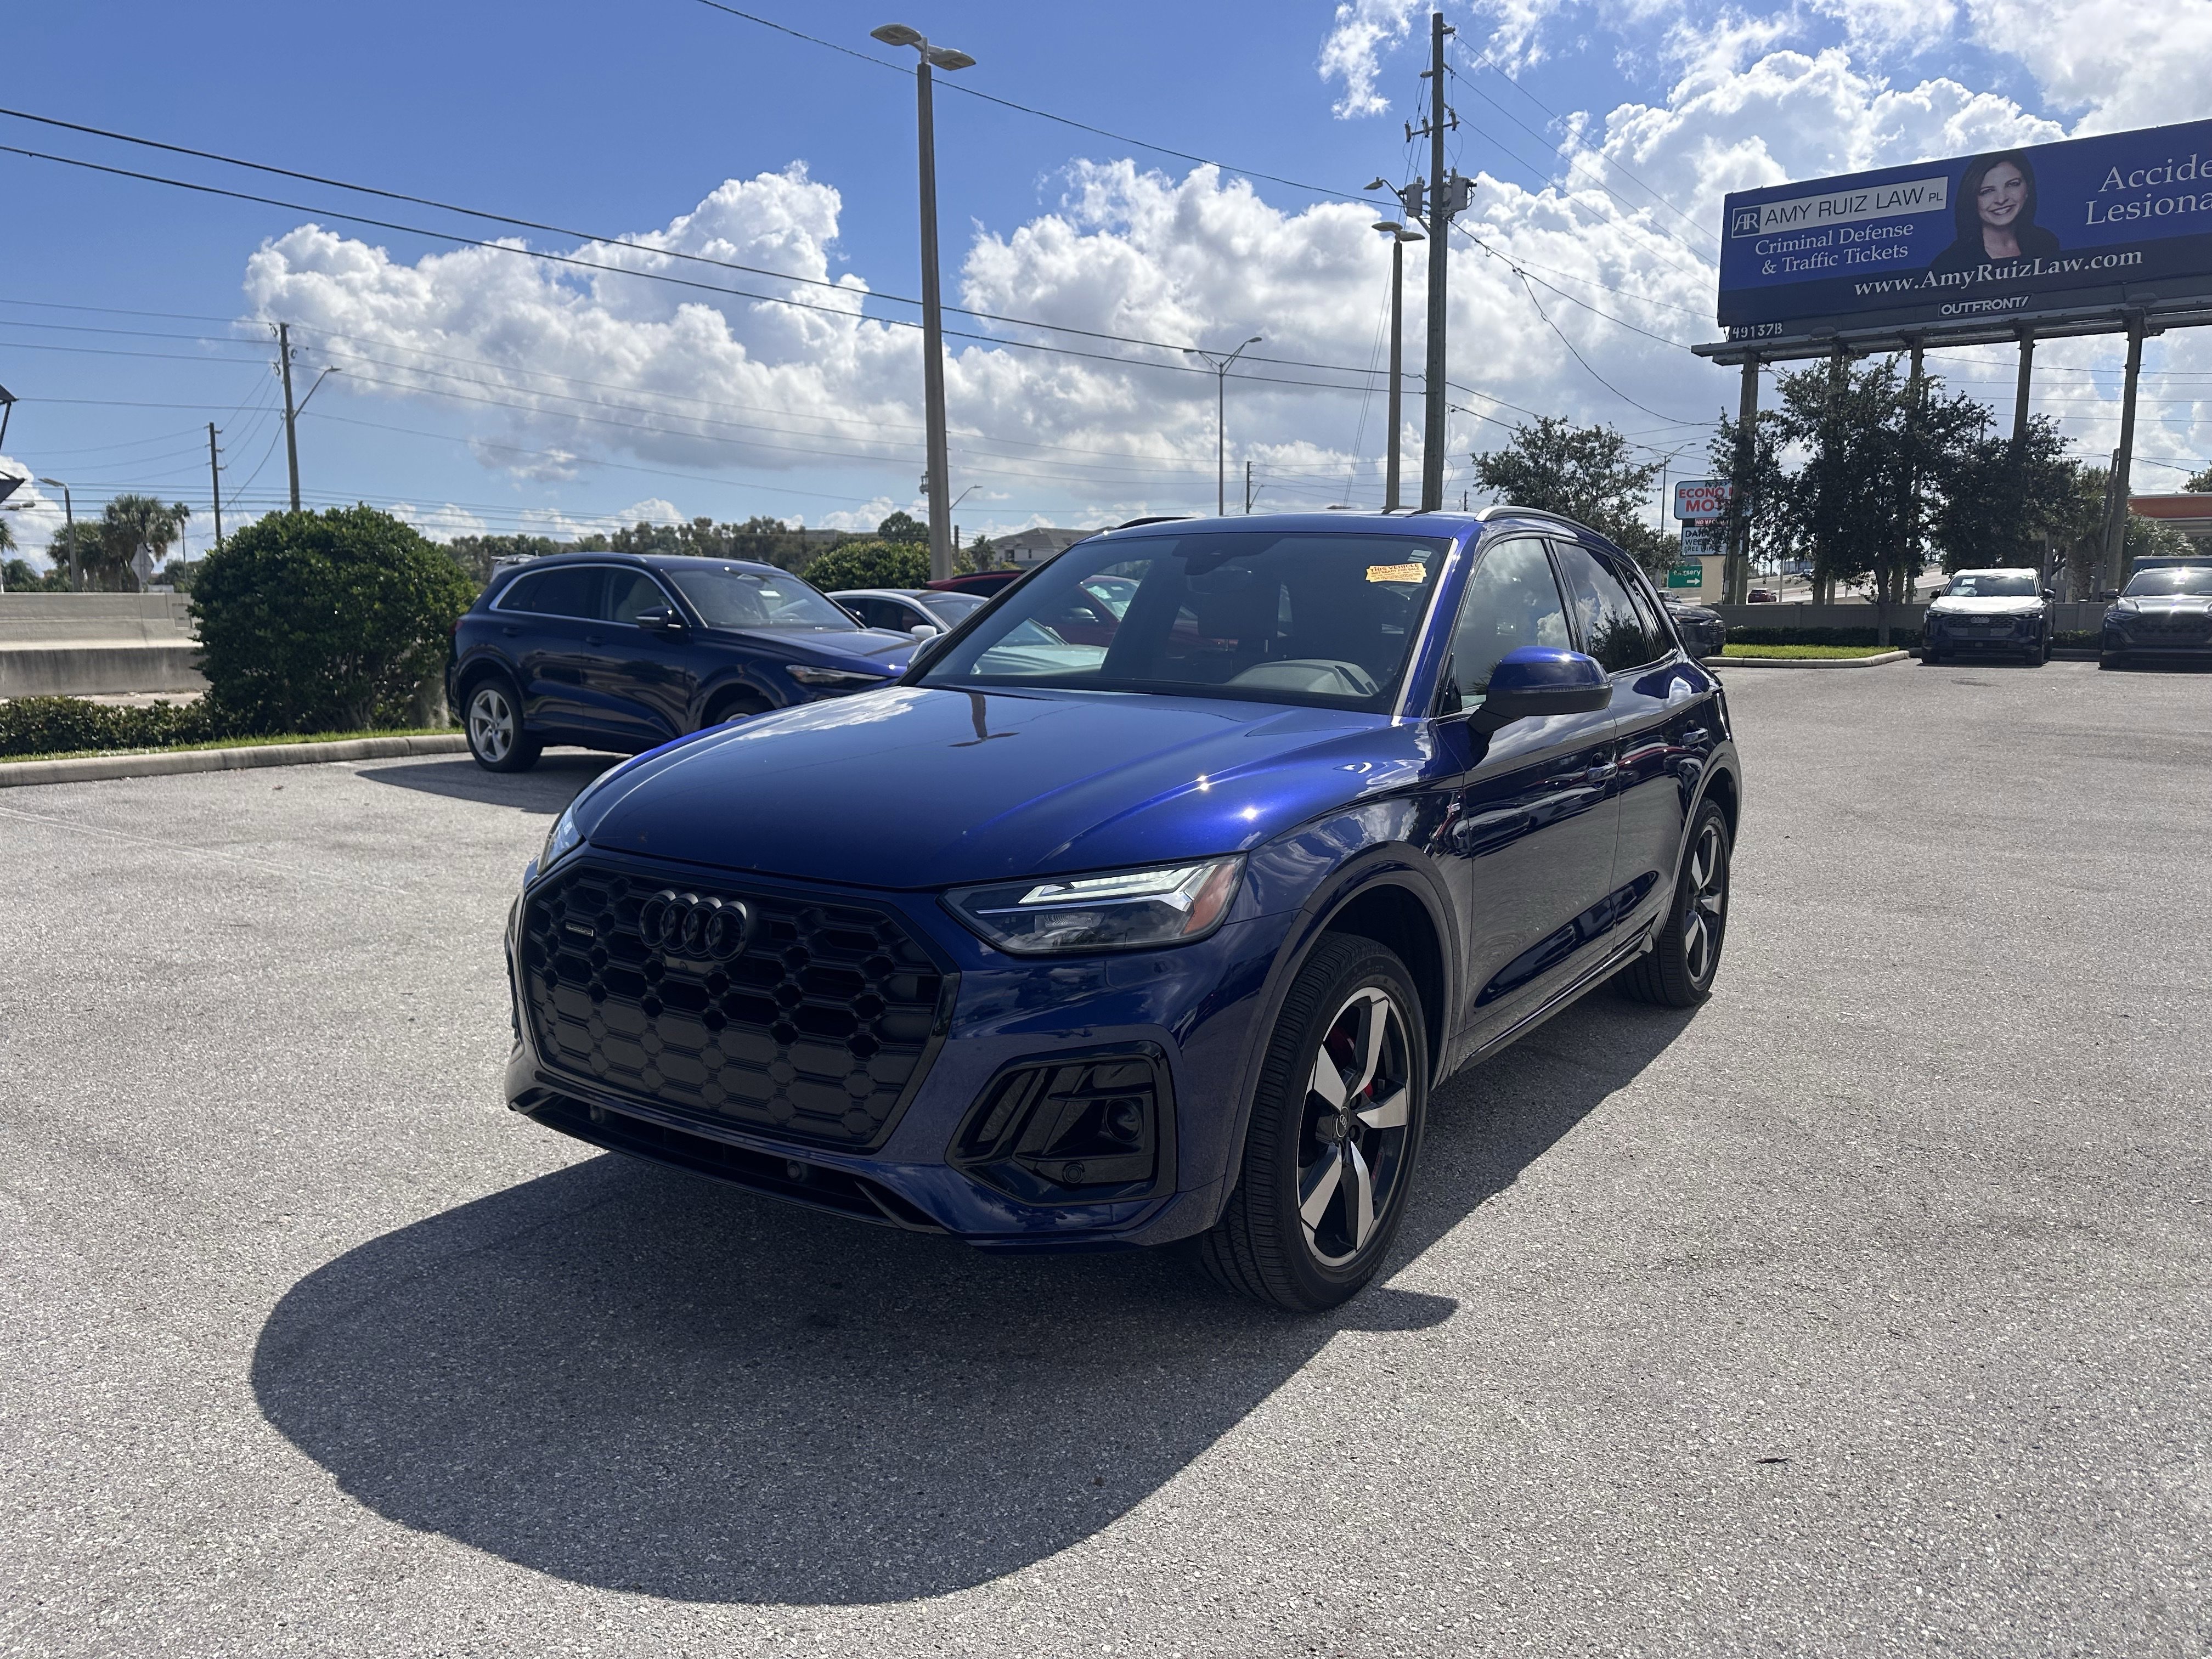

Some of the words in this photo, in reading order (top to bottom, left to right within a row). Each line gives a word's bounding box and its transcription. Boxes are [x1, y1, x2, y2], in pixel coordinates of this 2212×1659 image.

[2098, 154, 2212, 192] Accide
[1765, 203, 1812, 225] AMY
[1819, 195, 1867, 217] RUIZ
[1876, 187, 1924, 209] LAW
[1929, 192, 1943, 202] PL
[2085, 193, 2212, 225] Lesiona
[1756, 230, 1833, 255] Criminal
[1839, 223, 1914, 242] Defense
[1762, 259, 1777, 274] &
[1782, 253, 1838, 273] Traffic
[1844, 245, 1908, 264] Tickets
[1854, 250, 2143, 296] www.AmyRuizLaw.com
[1679, 487, 1725, 498] ECONO
